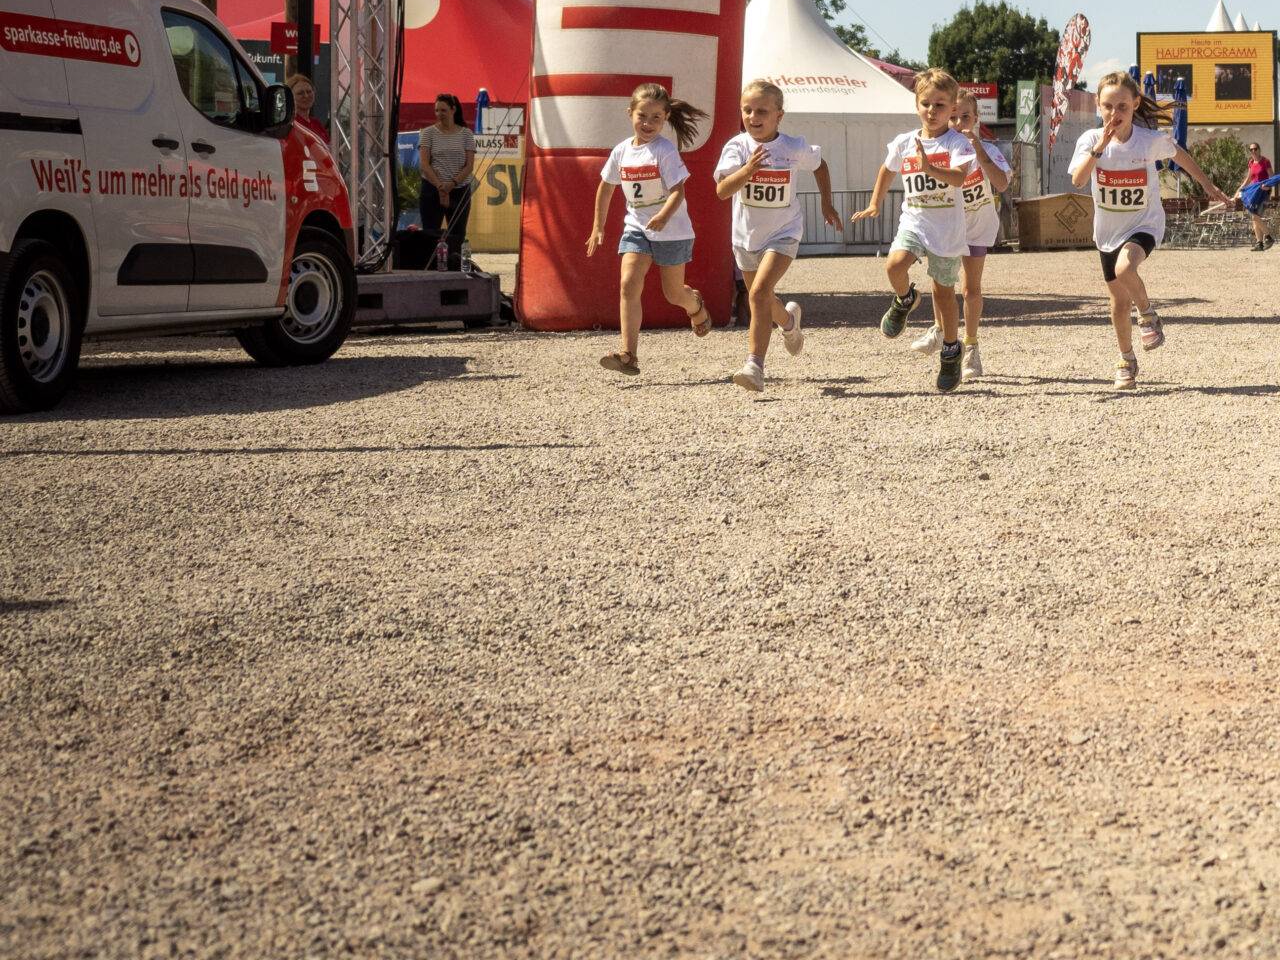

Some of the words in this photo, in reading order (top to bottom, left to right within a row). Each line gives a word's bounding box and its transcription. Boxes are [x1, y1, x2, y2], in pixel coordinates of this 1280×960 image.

[4, 24, 122, 57] sparkasse-freiburg.de
[1190, 38, 1211, 46] Heute
[1156, 47, 1257, 59] HAUPTPROGRAMM
[763, 74, 868, 88] irkenmeier
[30, 159, 91, 194] Weil's
[98, 169, 126, 193] um
[131, 164, 174, 197] mehr
[179, 166, 201, 198] als
[206, 168, 240, 201] Geld
[242, 170, 278, 208] geht.
[755, 175, 787, 183] Sparkasse
[1109, 177, 1144, 185] Sparkasse
[632, 182, 643, 199] 2
[744, 183, 785, 202] 1501
[1098, 186, 1145, 206] 1182
